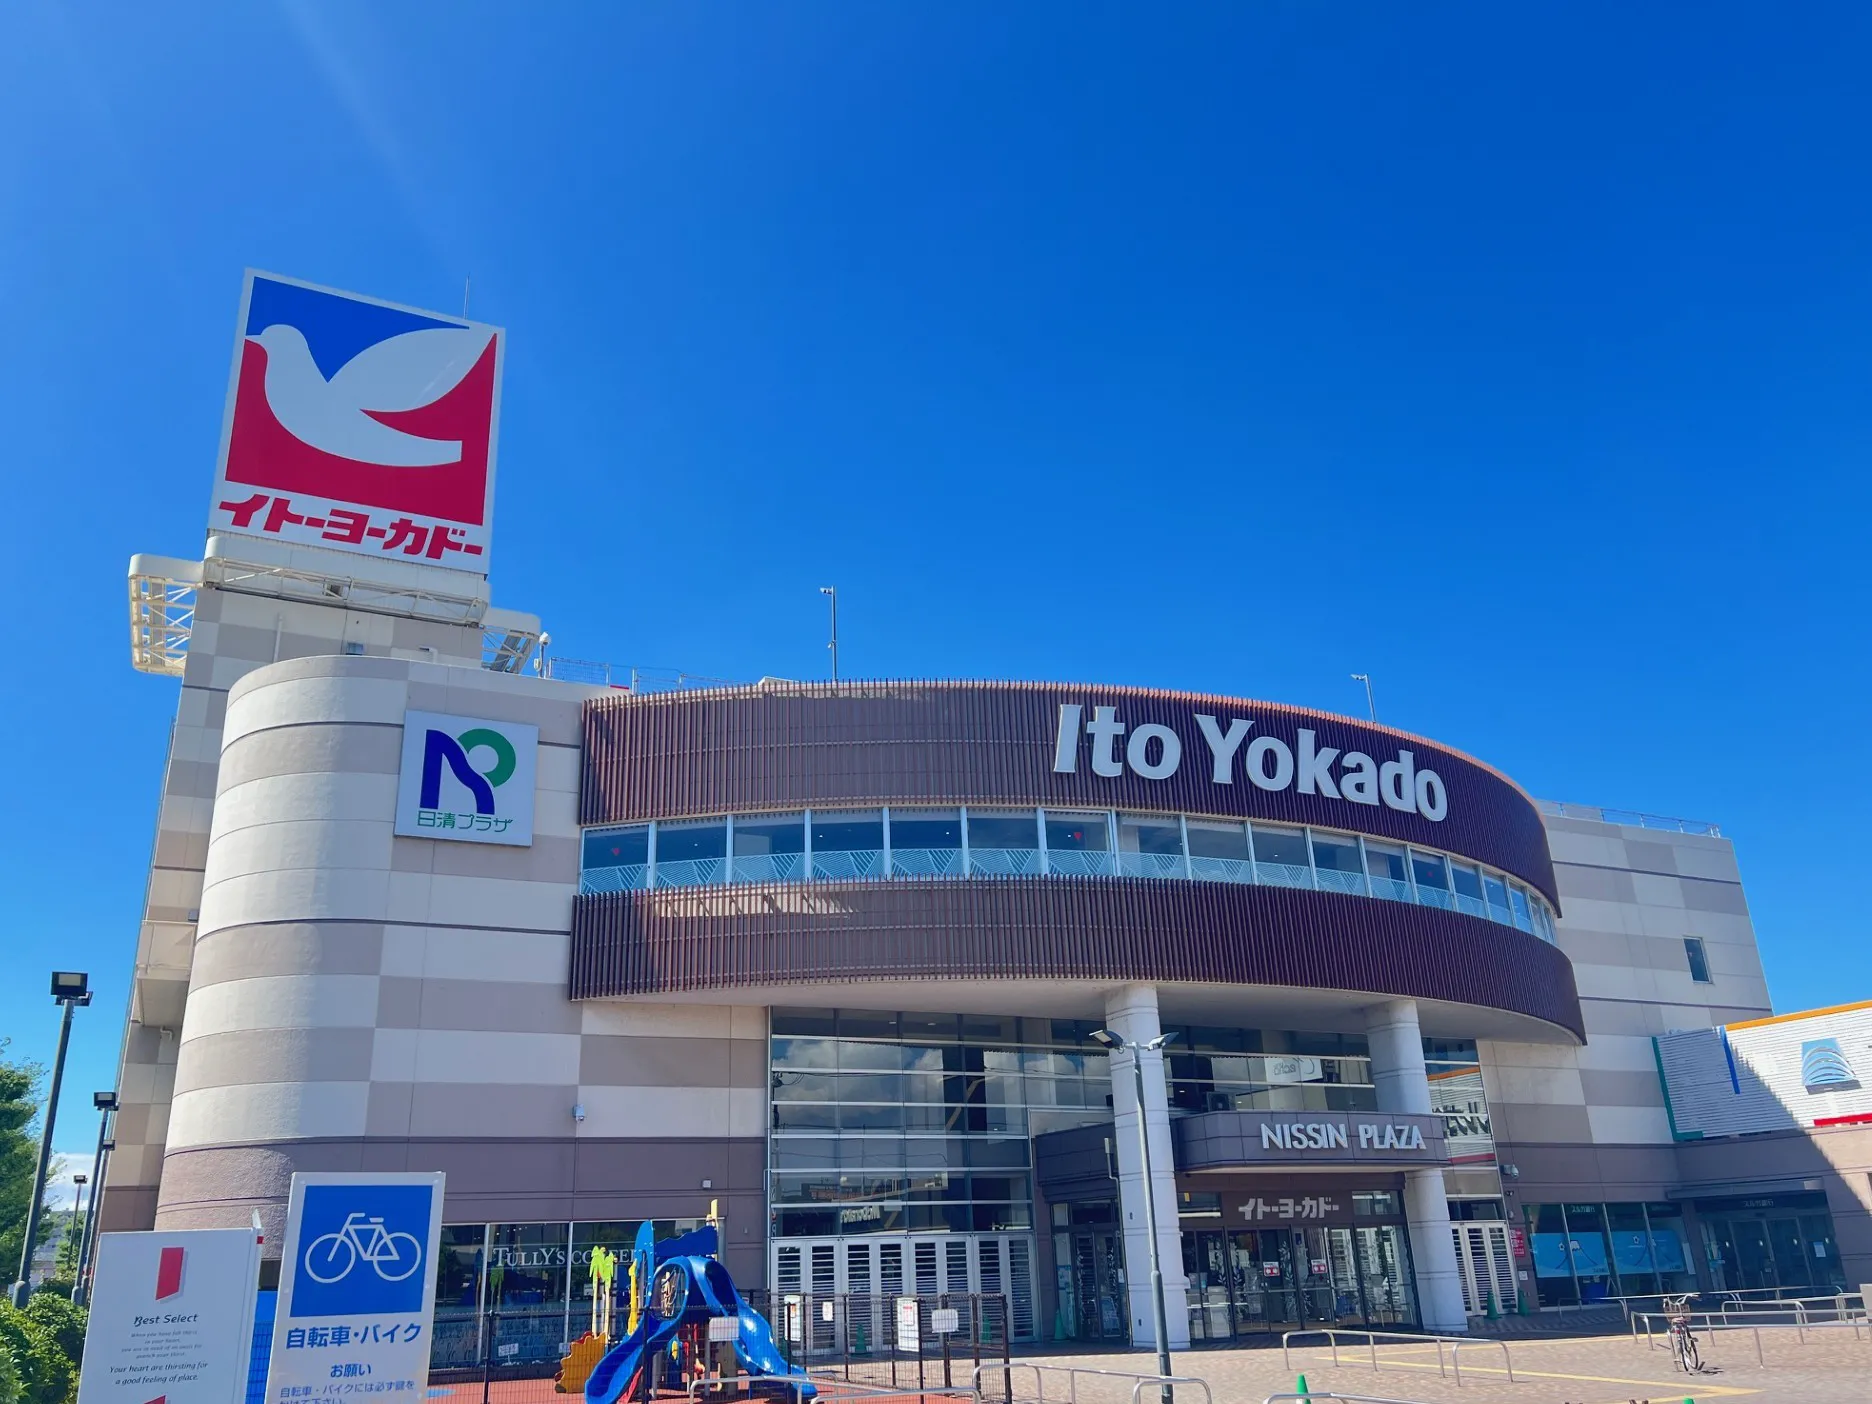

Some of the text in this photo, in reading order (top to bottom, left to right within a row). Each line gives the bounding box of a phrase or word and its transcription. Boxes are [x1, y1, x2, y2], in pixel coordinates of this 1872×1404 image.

[219, 493, 483, 560] イトーヨーカドー
[1053, 704, 1448, 821] Ito Yokado
[417, 810, 513, 832] 日清プラザ
[1260, 1123, 1427, 1150] NISSIN PLAZA
[1238, 1196, 1340, 1220] イトーヨーカドー
[133, 1313, 199, 1328] Best Select
[286, 1323, 422, 1350] 自転車・バイク
[129, 1364, 149, 1372] heart
[197, 1361, 208, 1370] for
[330, 1363, 372, 1378] お願い
[122, 1376, 141, 1386] good
